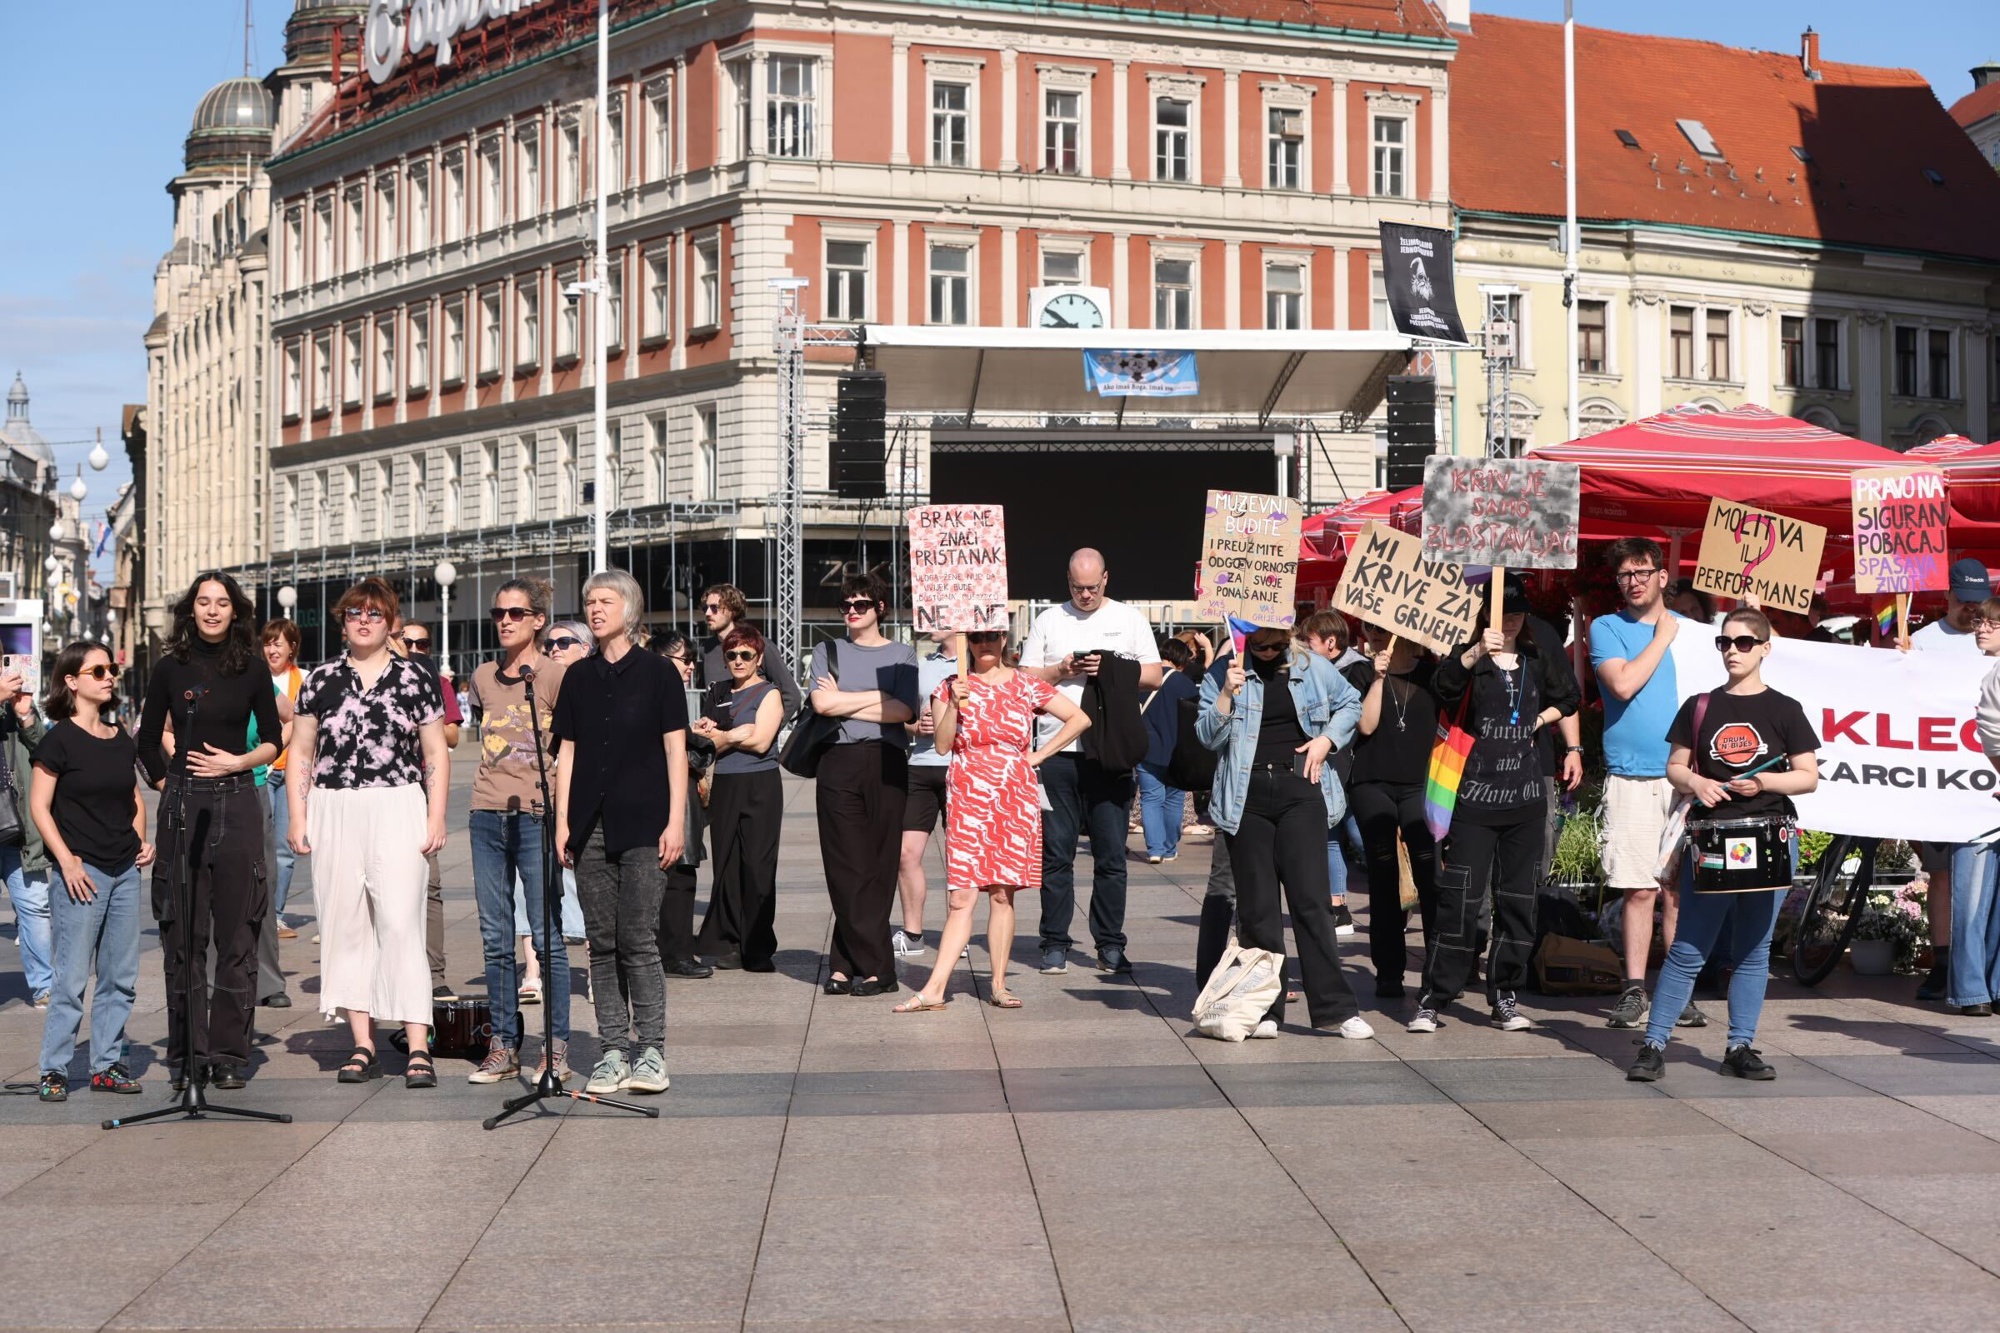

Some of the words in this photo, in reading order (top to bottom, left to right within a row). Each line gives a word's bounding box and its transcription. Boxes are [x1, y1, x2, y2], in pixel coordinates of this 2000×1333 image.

[1452, 468, 1511, 493] KRIV
[1520, 470, 1549, 498] JE
[1856, 476, 1915, 502] PRAVO
[1917, 475, 1945, 498] NA
[920, 511, 966, 528] BRAK
[973, 510, 994, 527] NE
[1471, 496, 1533, 518] SAMO
[1858, 502, 1946, 530] SIGURAN
[939, 528, 978, 547] ZNAČI
[1225, 515, 1282, 537] BUDITE
[1713, 504, 1803, 553] MOLITVA
[1210, 538, 1215, 550] I
[1366, 531, 1400, 563] MI
[1426, 523, 1577, 559] ZLOSTAVLJAČ
[1858, 527, 1946, 555] POBAČAJ
[915, 547, 1002, 566] PRISTANAK
[1740, 543, 1762, 566] ILI
[1227, 571, 1243, 584] ZA
[1253, 574, 1283, 589] SVOJE
[1351, 555, 1431, 606] KRIVE
[1435, 591, 1473, 623] ZA
[1696, 566, 1810, 610] PERFORMANS
[917, 605, 951, 631] NE
[974, 603, 1006, 630] NE
[1345, 583, 1385, 616] VAŠE
[1393, 603, 1468, 646] GRIJEHE
[1723, 736, 1746, 744] DRUM
[1937, 768, 2000, 792] KO
